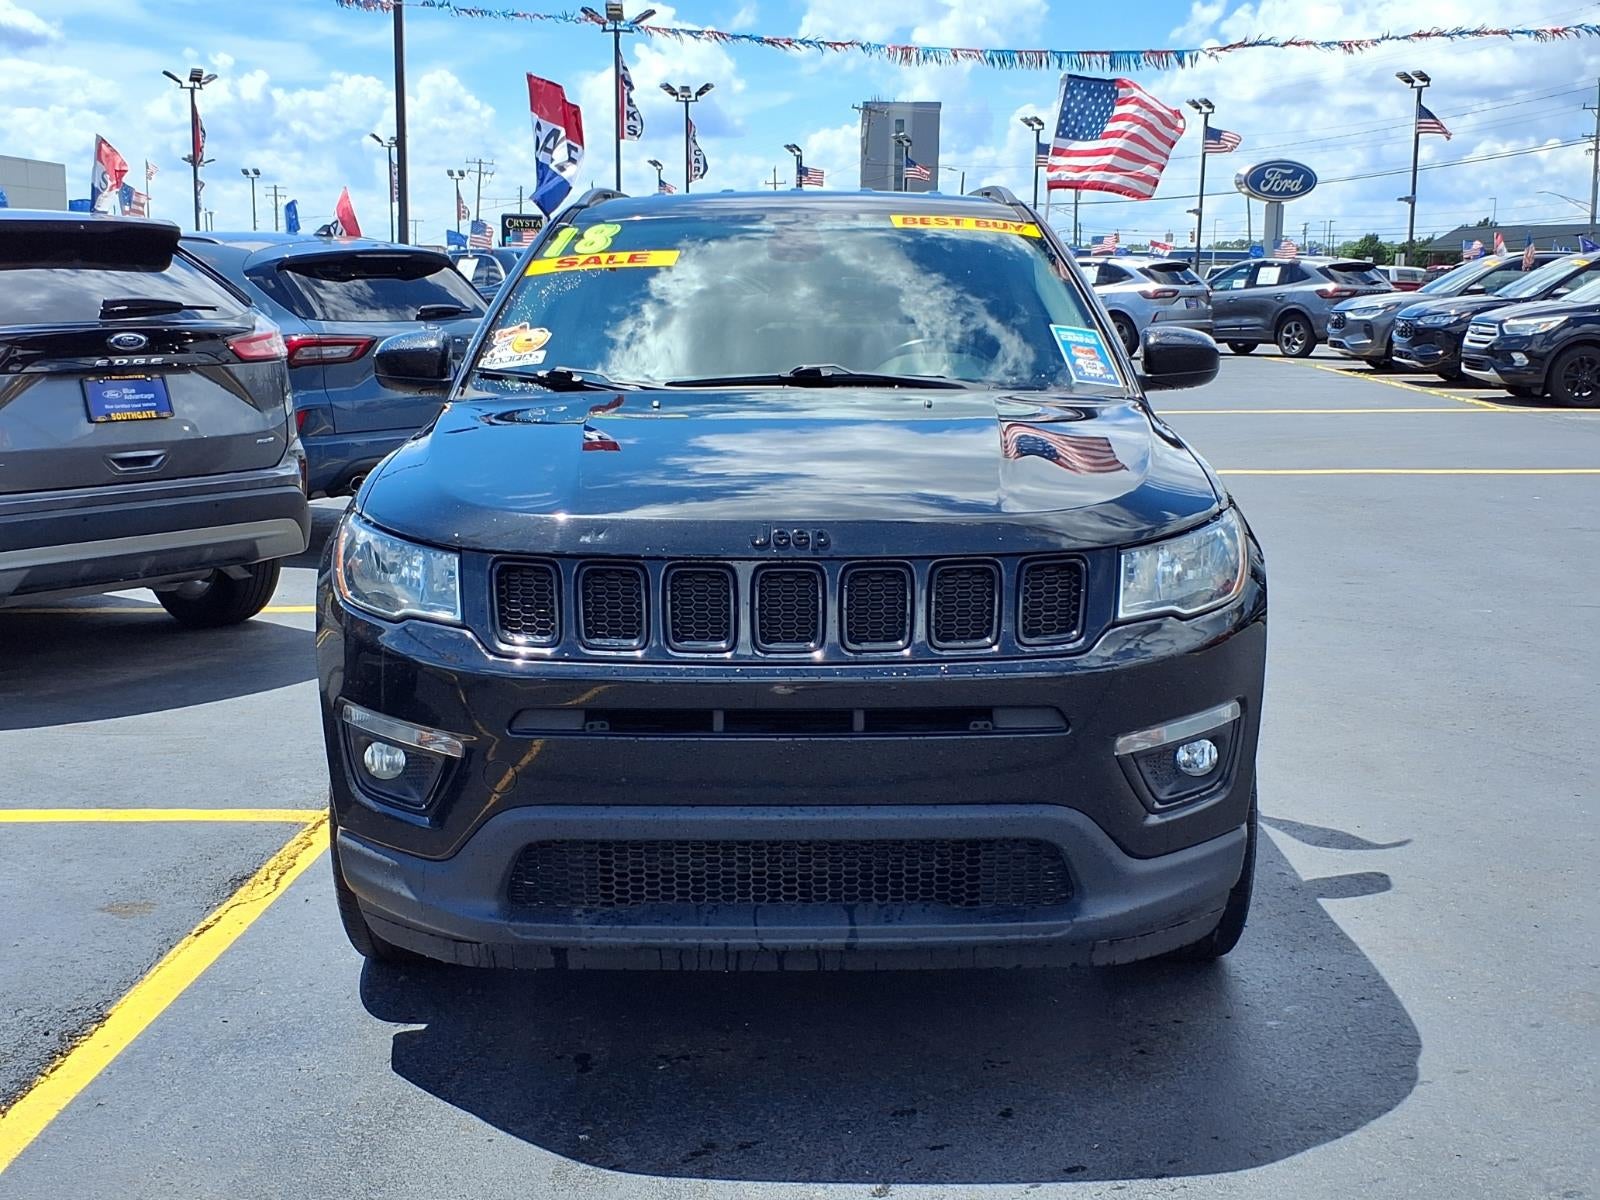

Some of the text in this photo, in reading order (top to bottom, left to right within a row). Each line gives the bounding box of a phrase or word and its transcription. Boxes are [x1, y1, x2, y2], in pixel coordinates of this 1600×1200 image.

[1260, 167, 1304, 192] Ford
[505, 217, 542, 229] CRYSTA
[902, 216, 1025, 232] BEST BUY
[543, 224, 622, 258] 18
[555, 253, 650, 268] SALE
[95, 358, 163, 367] EDGE
[110, 410, 157, 420] SOUTHGATE
[749, 522, 832, 553] Jeep
